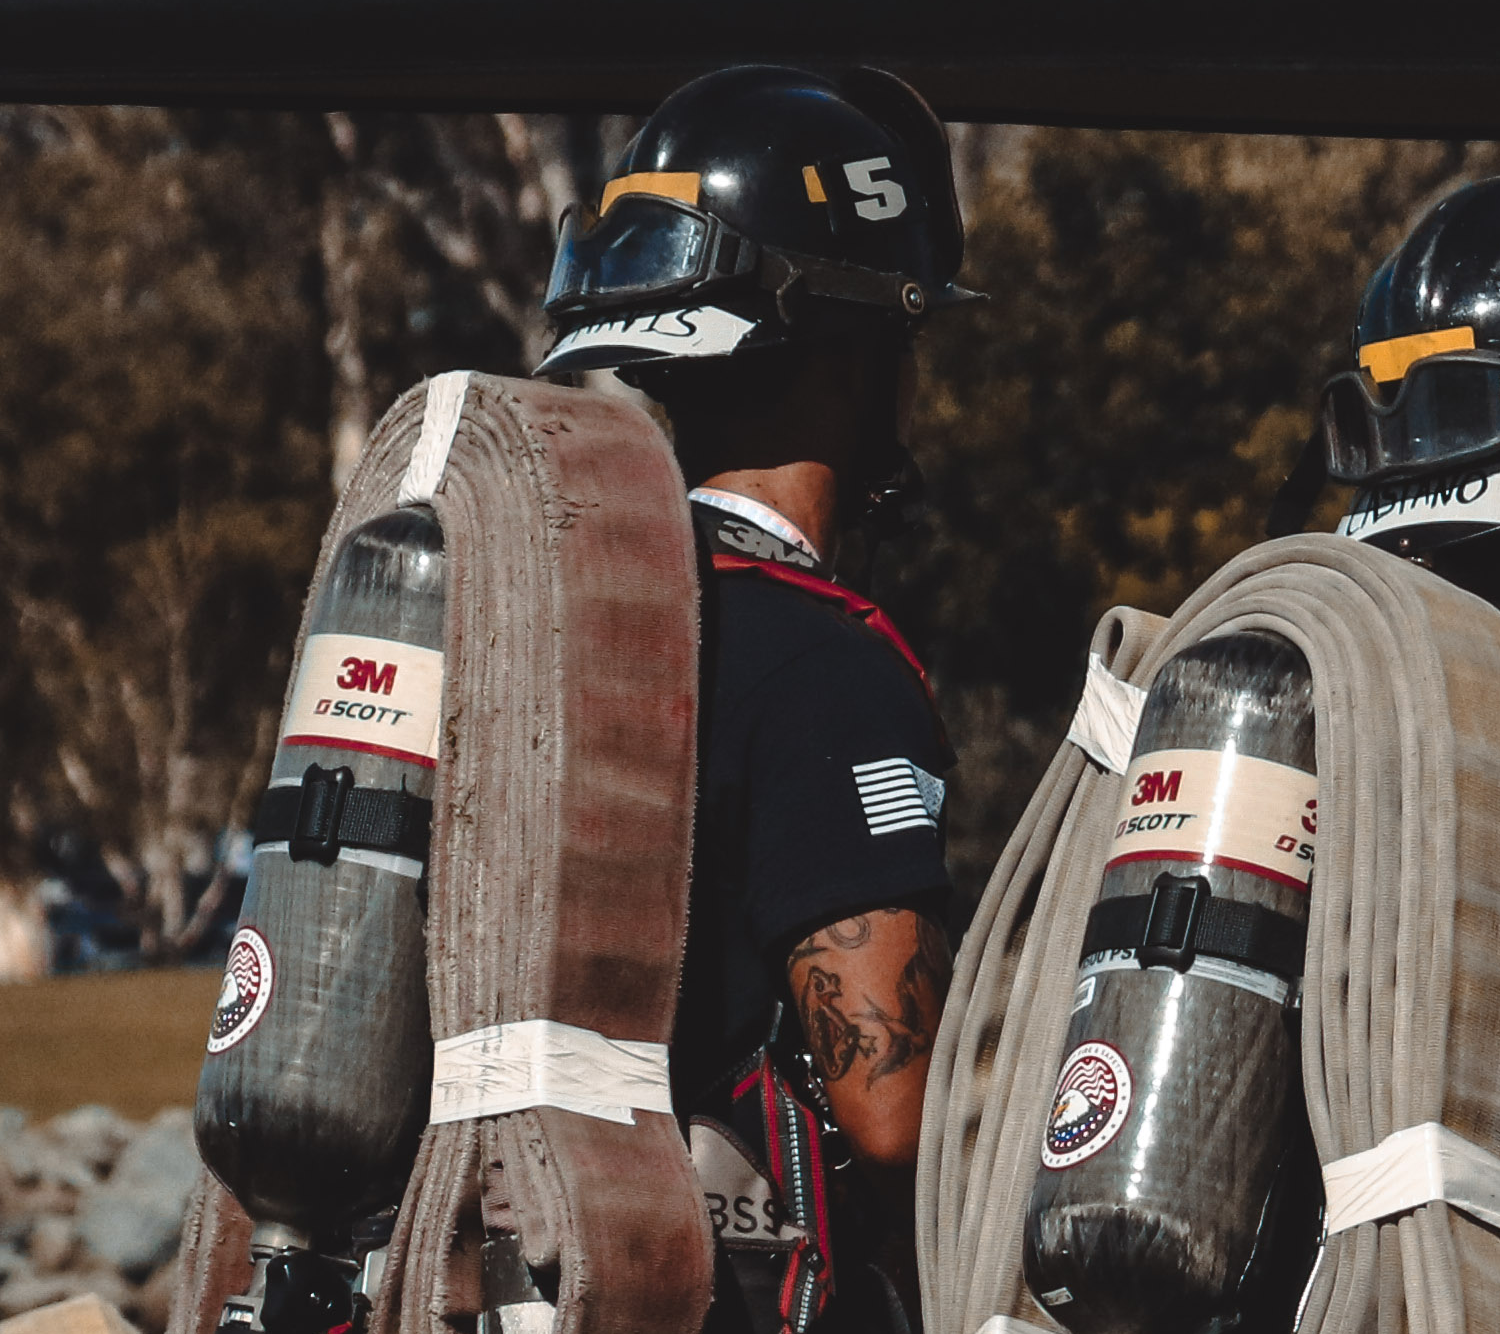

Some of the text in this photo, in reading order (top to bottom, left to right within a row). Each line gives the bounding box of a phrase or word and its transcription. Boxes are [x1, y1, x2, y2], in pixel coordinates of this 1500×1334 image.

[842, 155, 908, 222] 5
[336, 656, 397, 697] 3M
[1131, 770, 1183, 805] 3M
